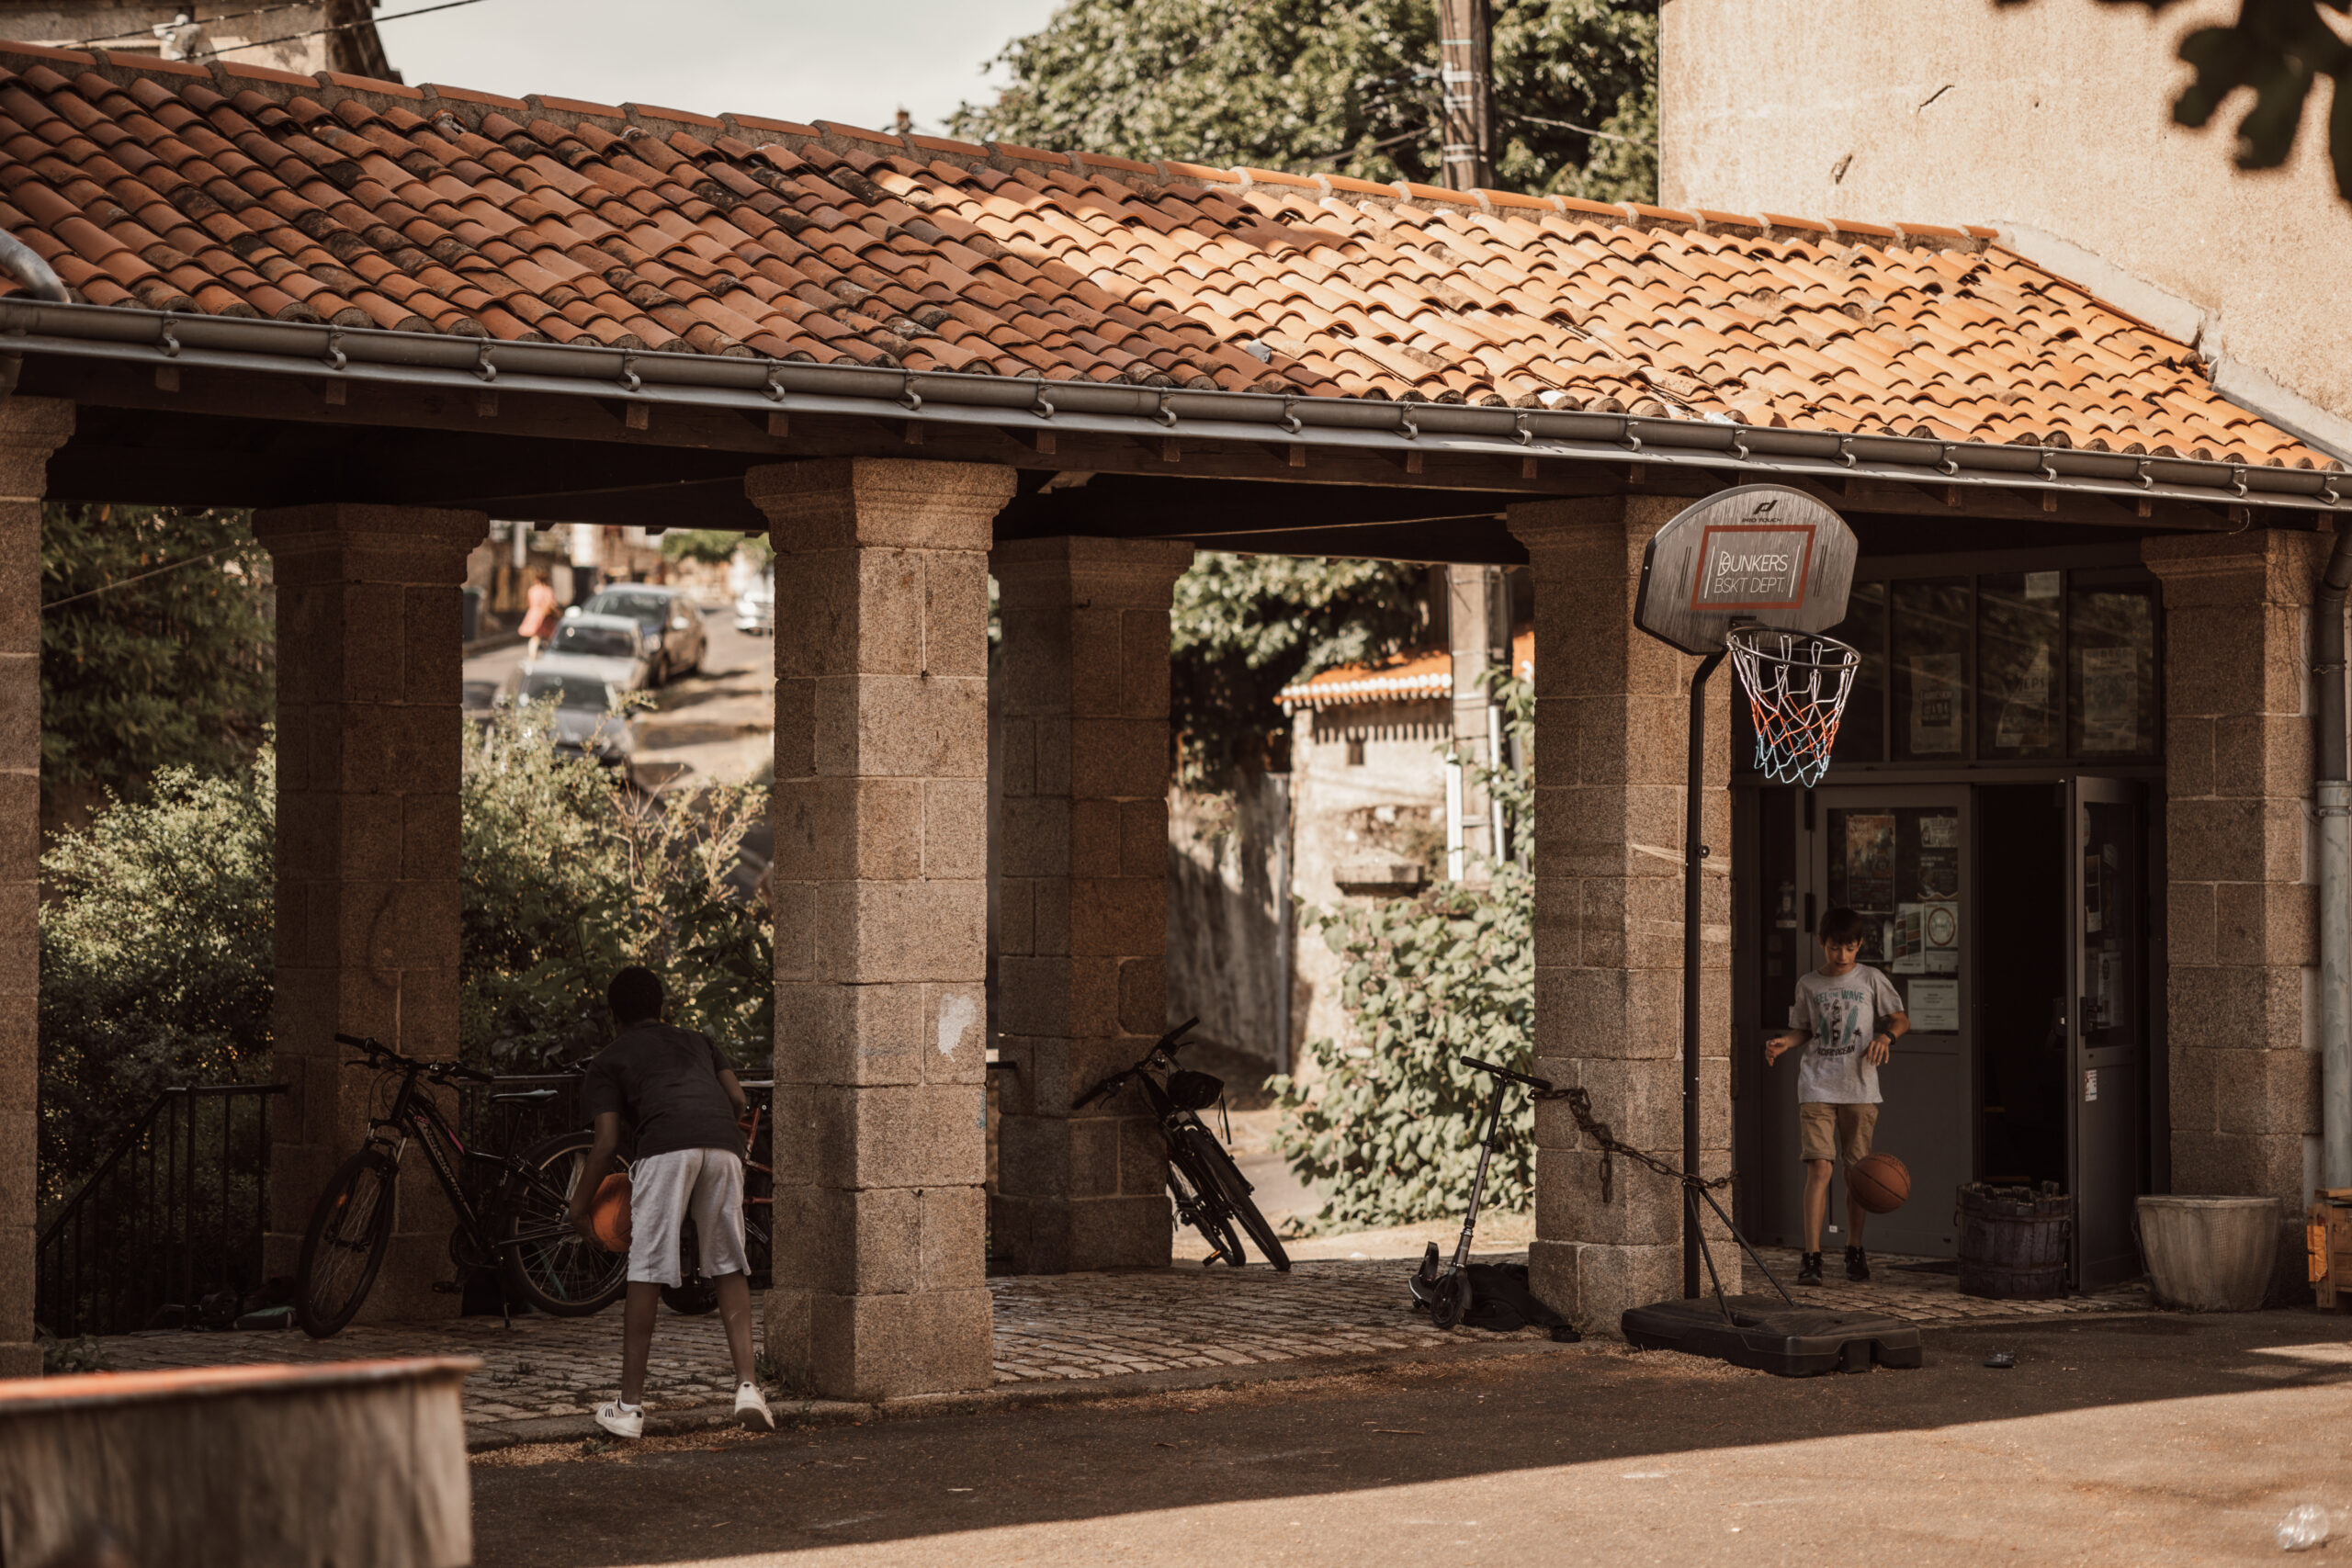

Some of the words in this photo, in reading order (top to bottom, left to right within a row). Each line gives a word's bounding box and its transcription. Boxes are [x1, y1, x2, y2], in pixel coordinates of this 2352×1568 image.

[1713, 578, 1748, 592] BSKT
[1750, 578, 1785, 592] DEPT.
[1841, 989, 1863, 1003] WAVE
